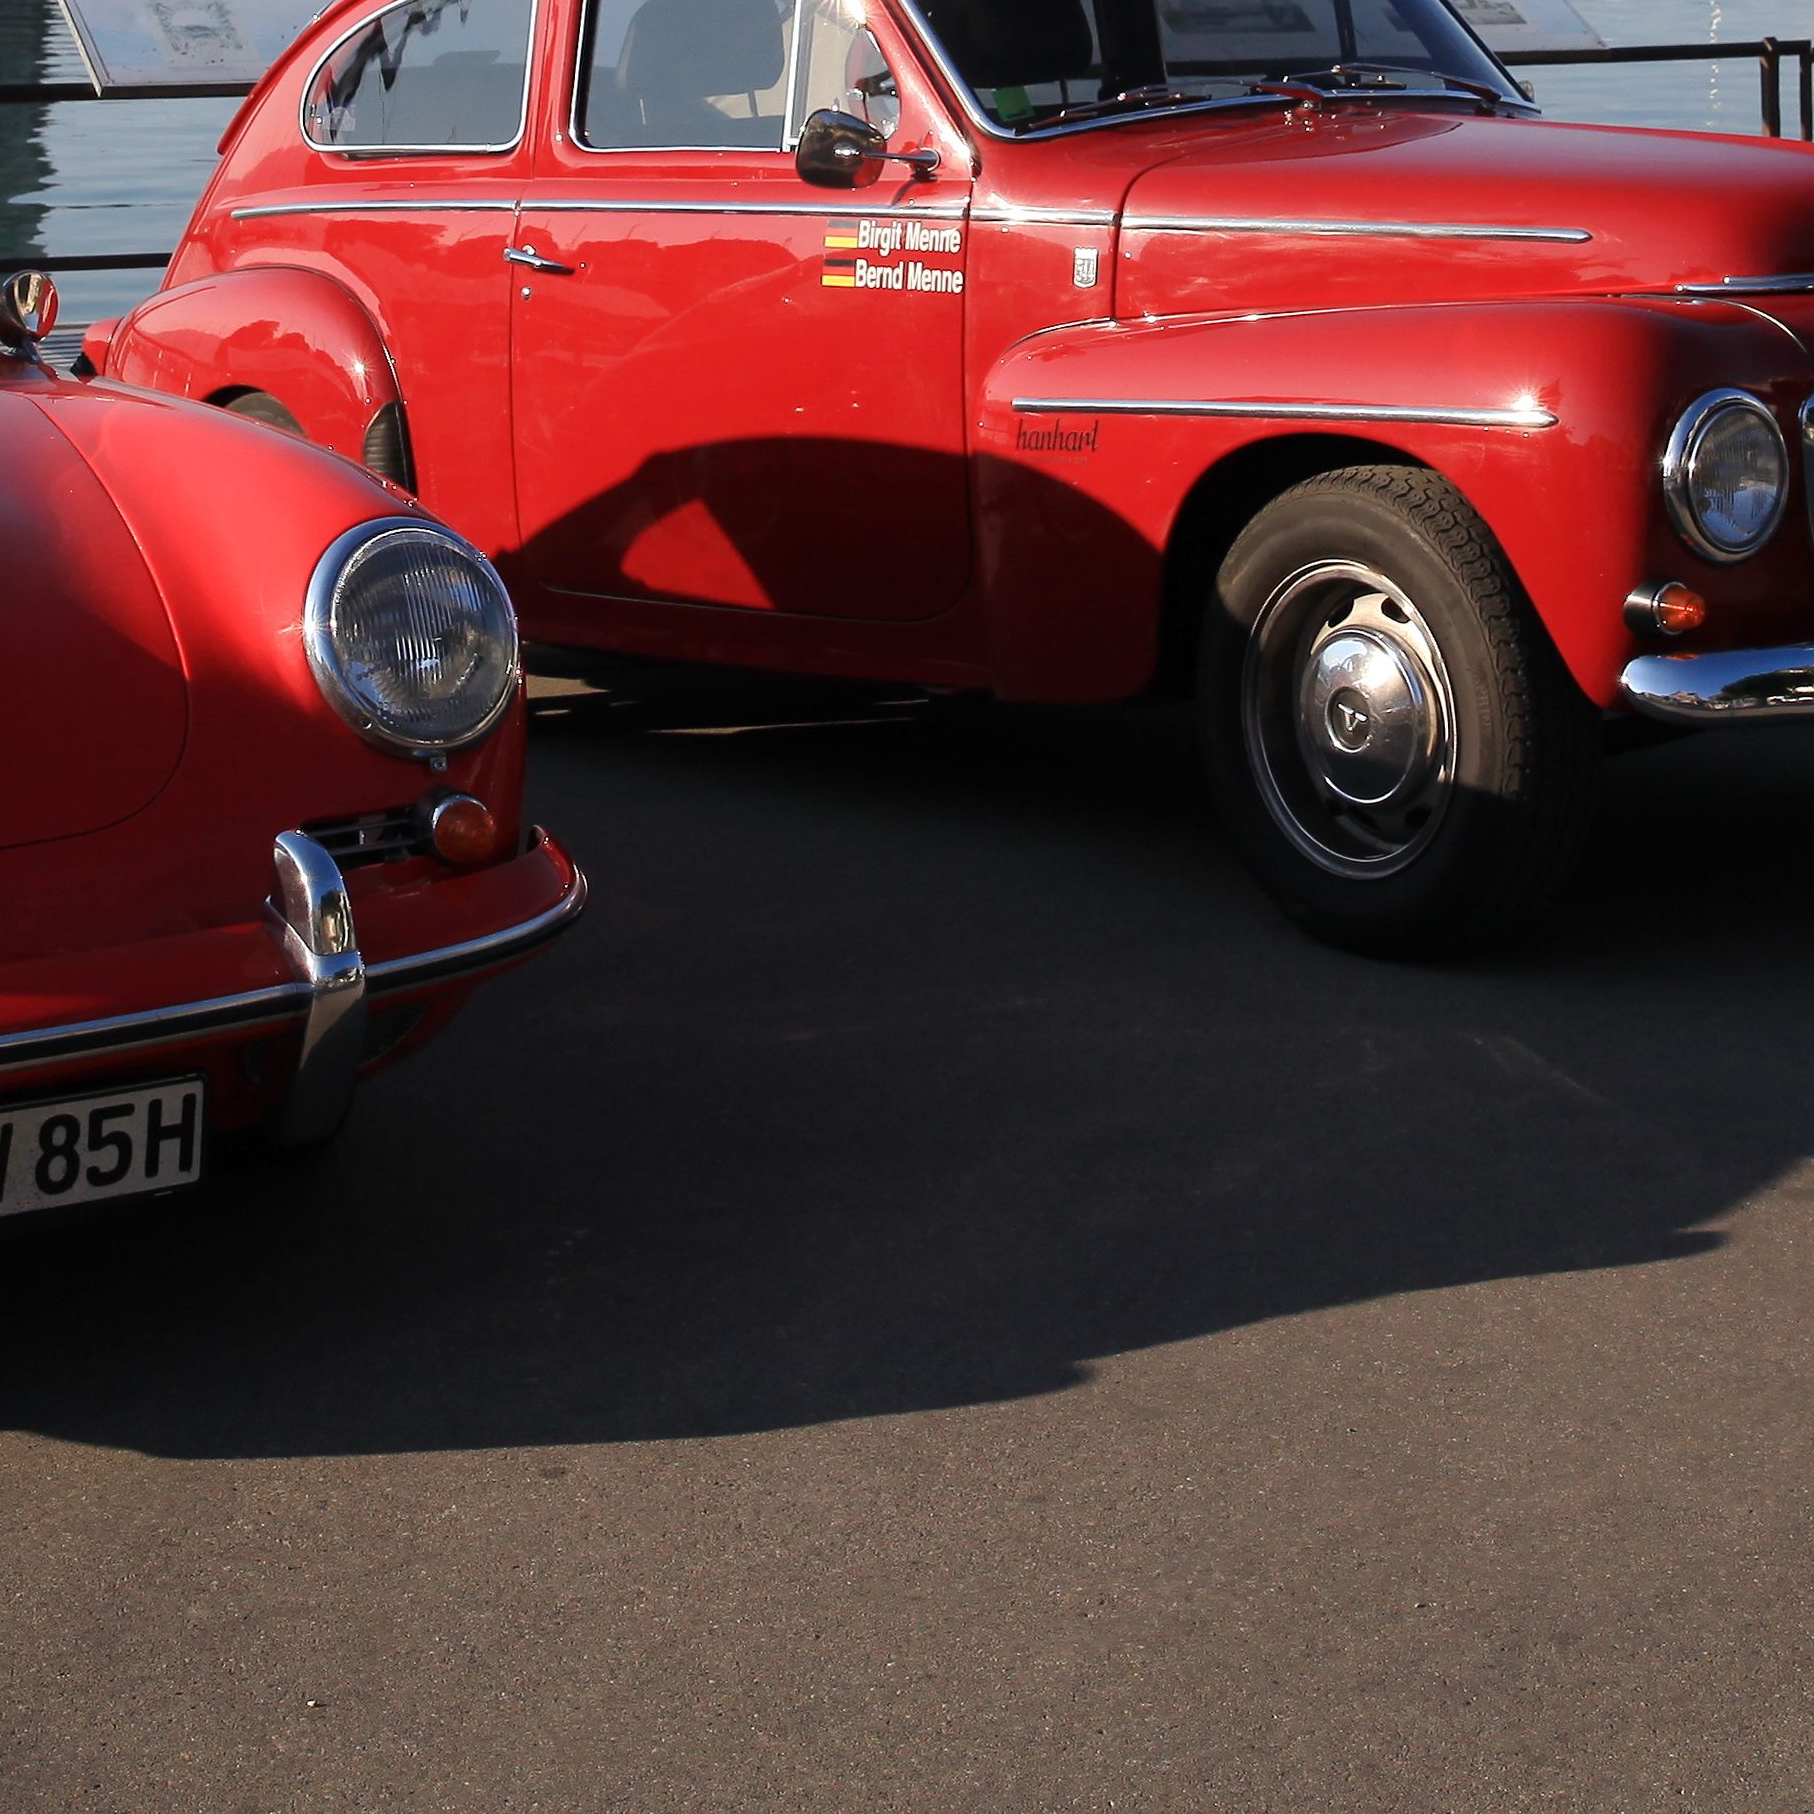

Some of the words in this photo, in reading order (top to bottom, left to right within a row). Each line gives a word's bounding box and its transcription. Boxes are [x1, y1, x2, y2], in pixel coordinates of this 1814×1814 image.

[858, 219, 902, 257] Birgit
[905, 221, 961, 254] Menne
[855, 258, 904, 290] Bernd
[907, 261, 964, 294] Menne
[33, 1091, 198, 1197] 85H
